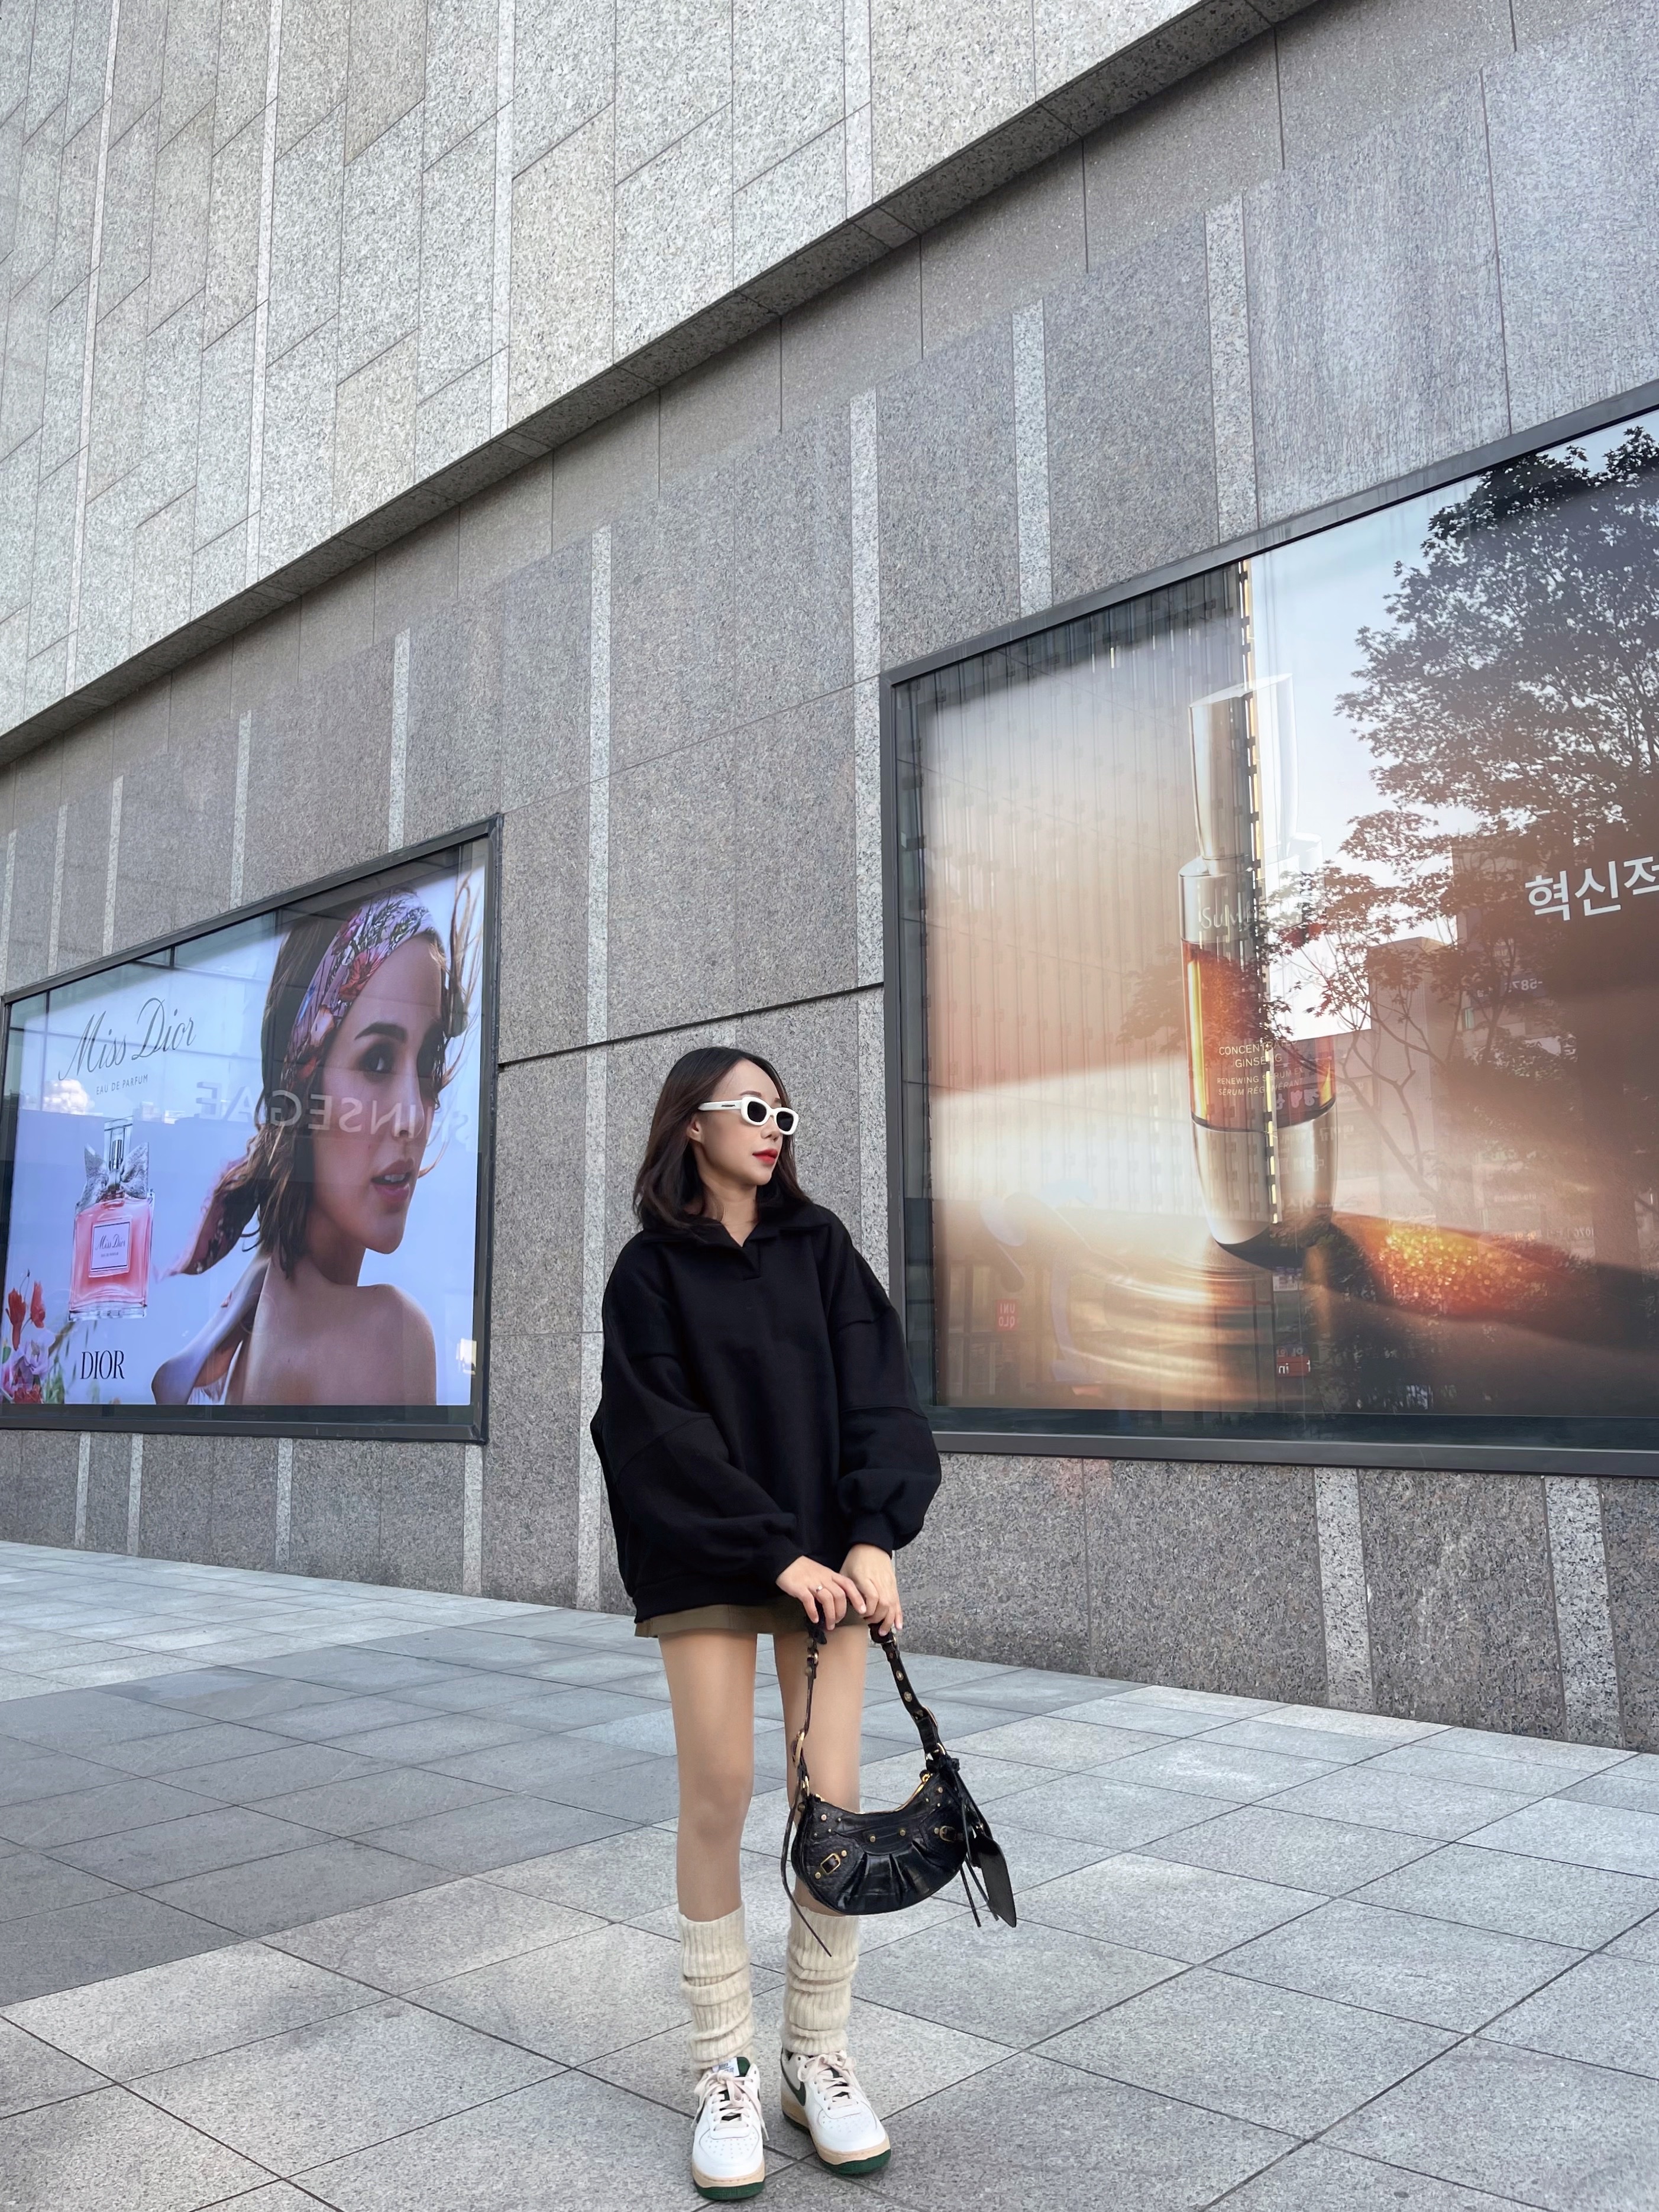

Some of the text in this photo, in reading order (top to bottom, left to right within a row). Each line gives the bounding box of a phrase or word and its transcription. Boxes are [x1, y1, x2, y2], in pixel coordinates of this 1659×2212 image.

[59, 997, 196, 1081] Miss Dior
[1235, 1053, 1282, 1068] GINSEG
[96, 1073, 148, 1095] EAU DE PARFUM
[1217, 1075, 1259, 1085] RENEWING
[80, 1350, 125, 1380] DIOR
